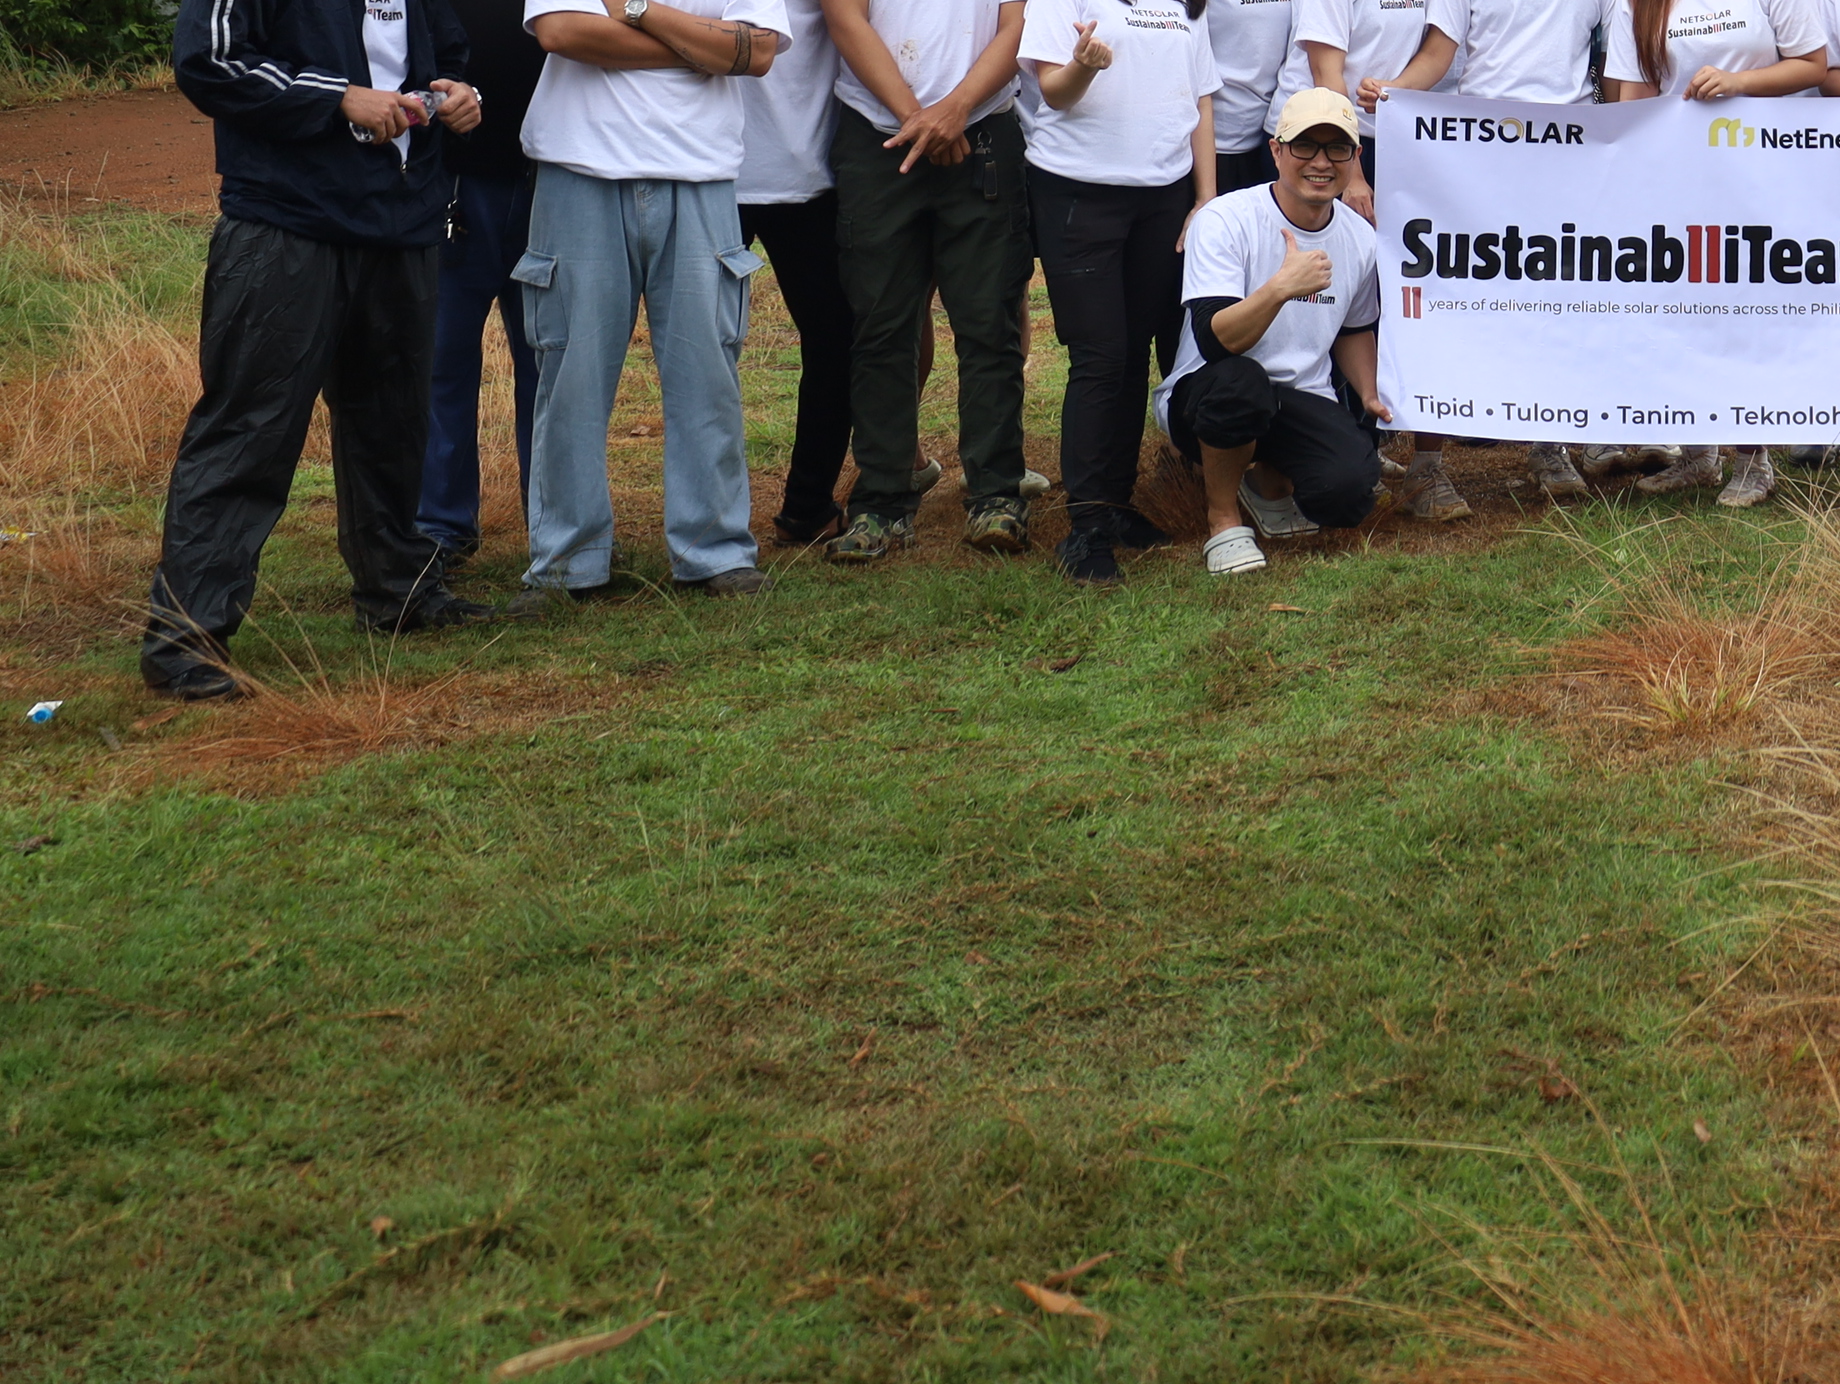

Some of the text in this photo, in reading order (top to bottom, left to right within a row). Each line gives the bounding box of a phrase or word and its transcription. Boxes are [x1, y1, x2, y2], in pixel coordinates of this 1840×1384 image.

[1130, 8, 1180, 18] NETSOLAR
[1680, 10, 1731, 24] NETSOLAR
[1415, 116, 1584, 145] NETSOLAR
[1428, 299, 1467, 312] years
[1471, 298, 1486, 311] of
[1489, 299, 1562, 316] delivering
[1566, 300, 1620, 313] reliable
[1624, 301, 1659, 314] solar
[1662, 302, 1729, 315] solutions
[1732, 304, 1778, 315] across
[1782, 303, 1806, 315] the
[1414, 395, 1473, 419] Tipid
[1501, 402, 1589, 428] Tulong
[1617, 404, 1695, 424] Tanim
